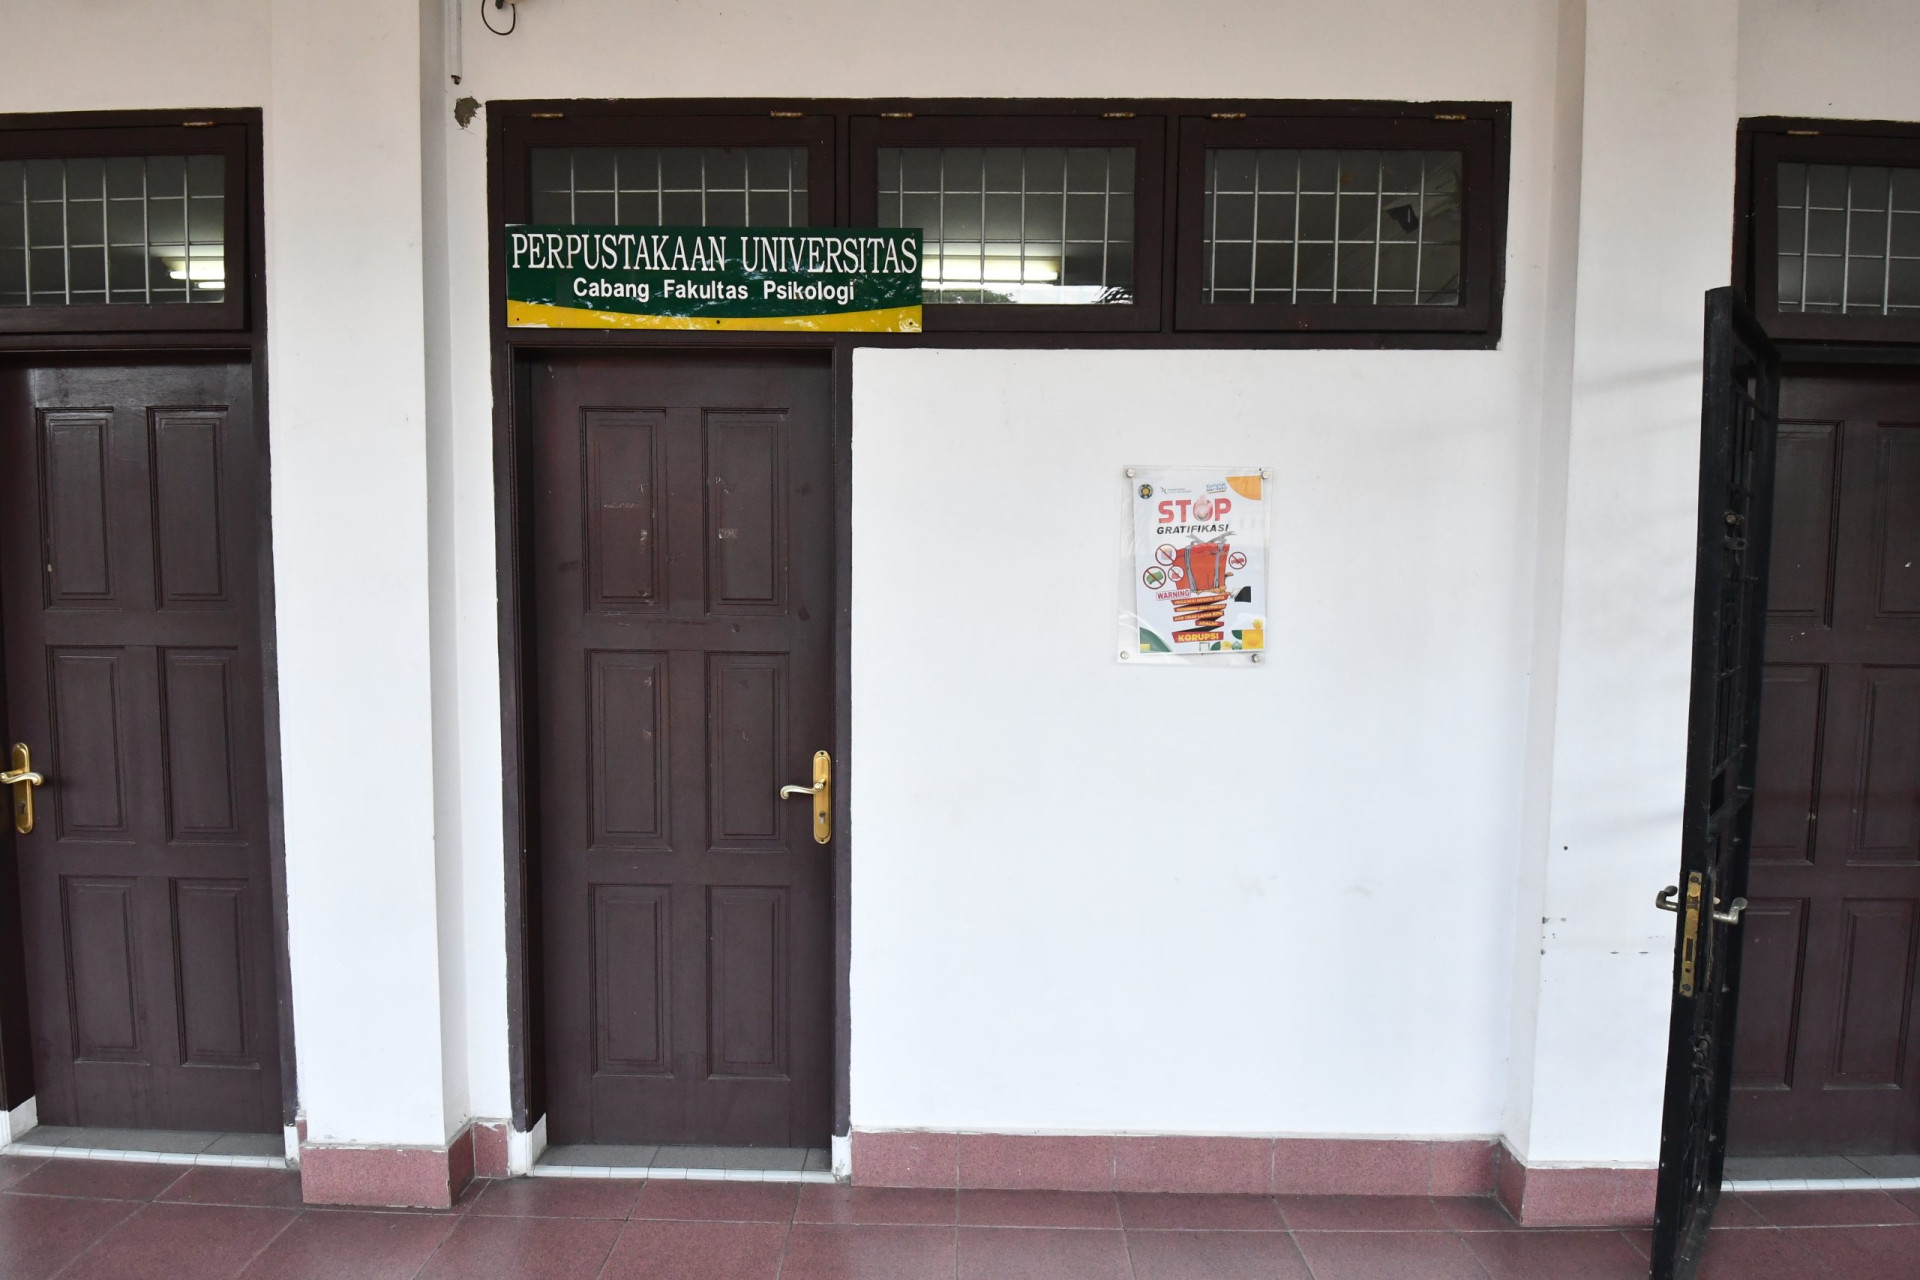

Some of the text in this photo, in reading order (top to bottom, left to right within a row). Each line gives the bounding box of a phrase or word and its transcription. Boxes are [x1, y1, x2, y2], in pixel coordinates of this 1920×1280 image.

[511, 233, 917, 274] PERPUSTAKAAN UNIVERSITAS
[573, 277, 855, 305] Cabang Fakultas Psikologi
[1158, 498, 1232, 523] STOP
[1156, 524, 1229, 535] GRATIFIKASI
[1157, 590, 1190, 600] WARNING
[1177, 633, 1219, 642] KORUPSI
